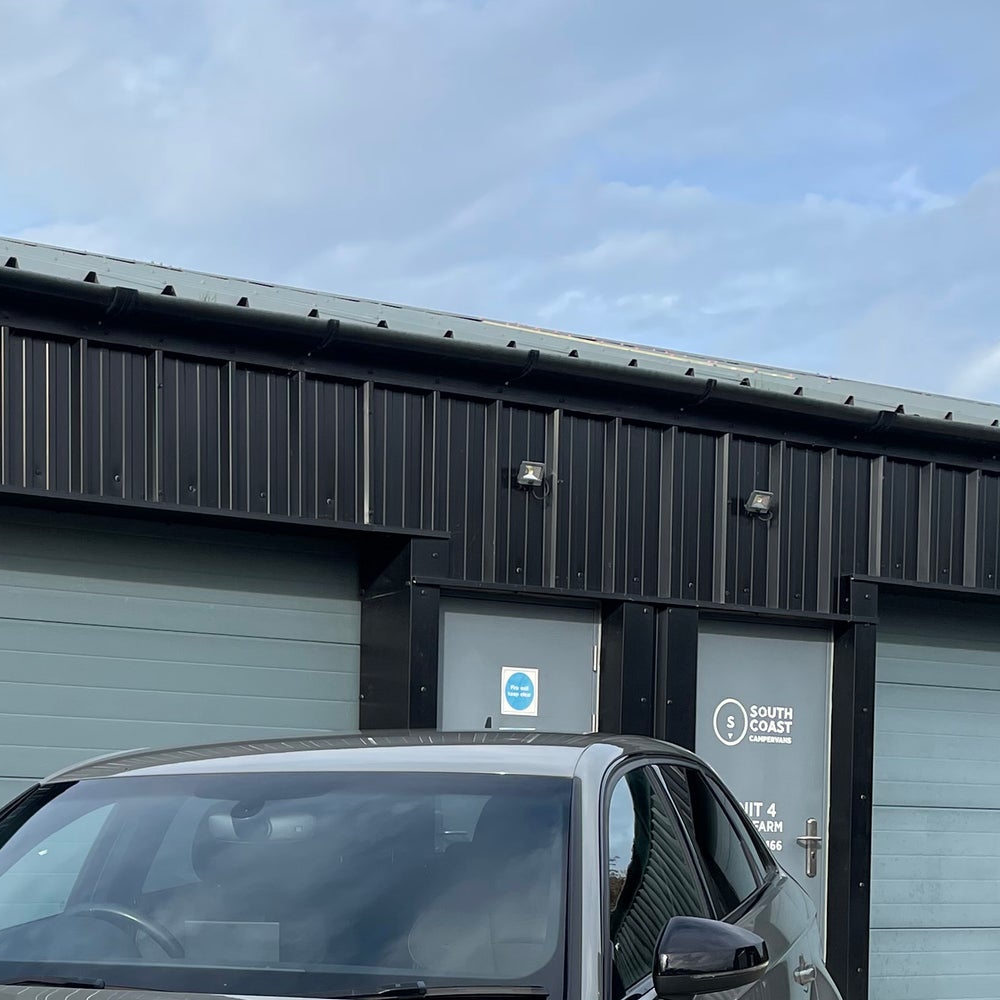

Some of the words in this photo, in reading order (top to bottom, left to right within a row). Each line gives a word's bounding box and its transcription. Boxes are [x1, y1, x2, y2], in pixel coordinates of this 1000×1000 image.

[749, 704, 793, 720] SOUTH
[749, 718, 793, 734] COAST
[748, 734, 793, 744] CAMPERVANS
[766, 802, 777, 818] 4
[752, 820, 783, 833] FARM
